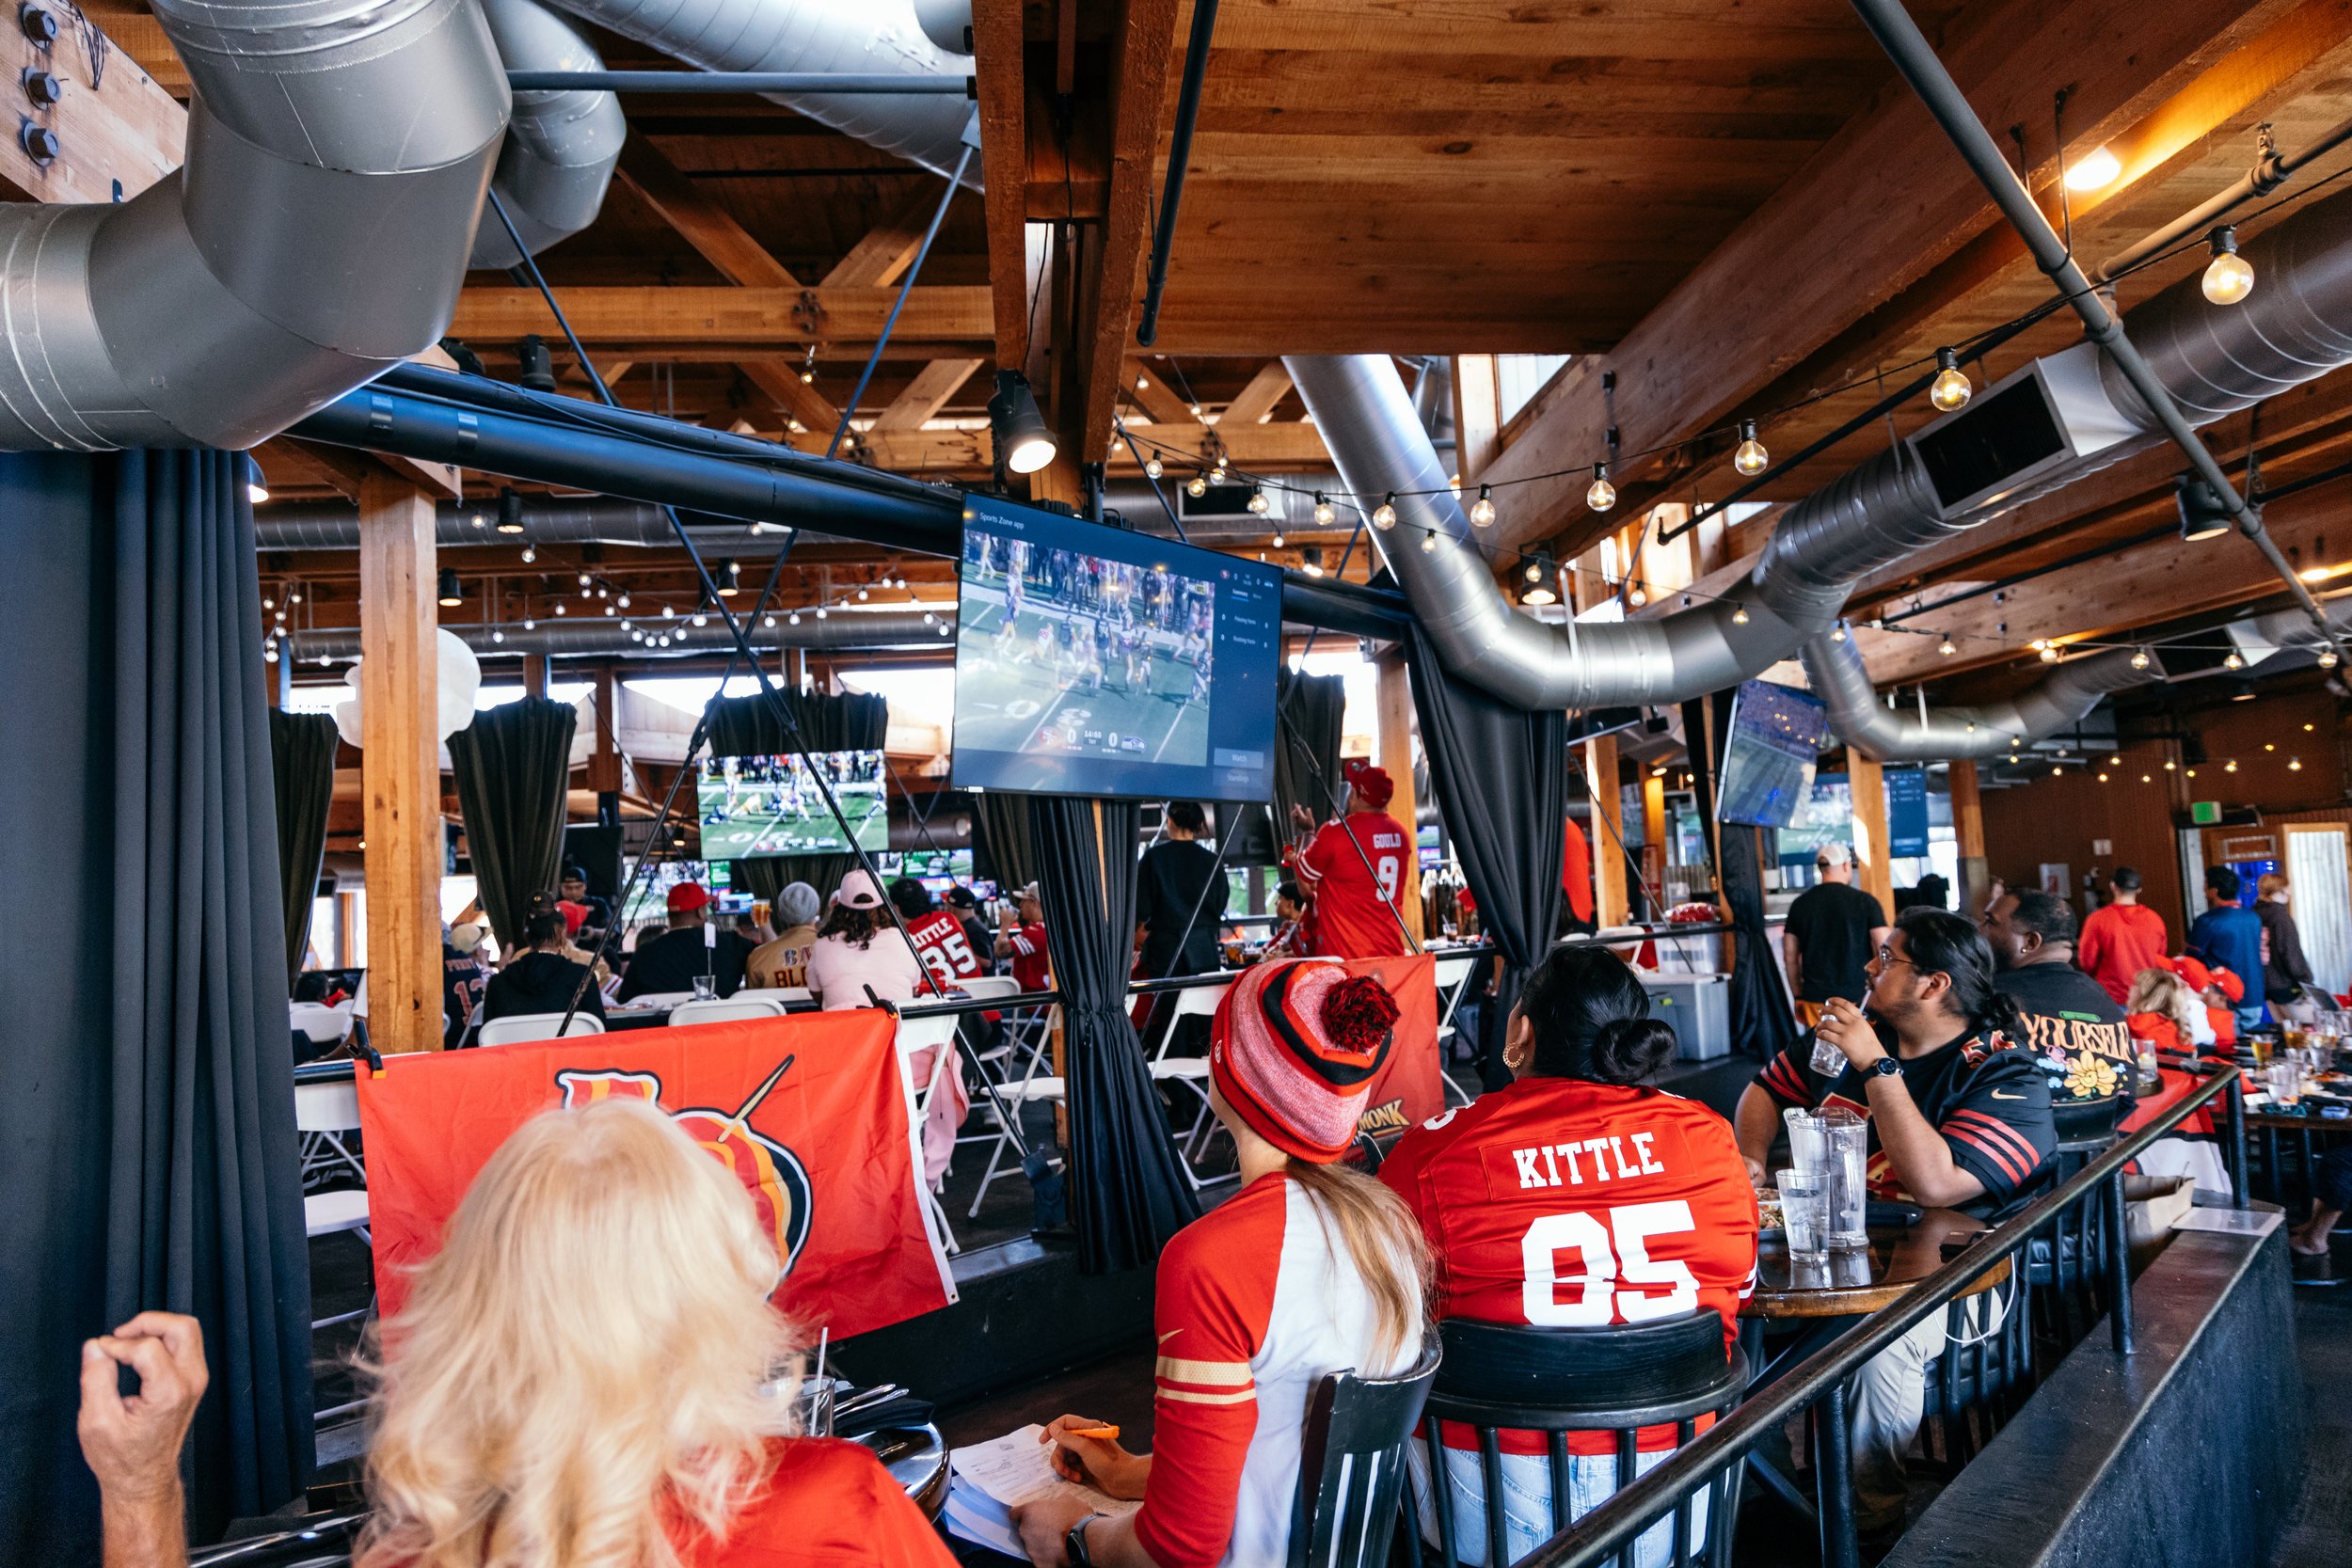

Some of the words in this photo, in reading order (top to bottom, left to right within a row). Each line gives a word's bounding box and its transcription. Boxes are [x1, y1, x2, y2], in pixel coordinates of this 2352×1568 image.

[979, 512, 998, 523] Sports
[998, 516, 1013, 527] Zone
[1013, 521, 1025, 531] app
[1067, 728, 1077, 744] 0
[1108, 732, 1118, 748] 0
[1373, 832, 1402, 849] GOULD
[1375, 855, 1399, 902] 9
[908, 916, 954, 948] KITTLE
[2019, 1011, 2136, 1065] YOURSELF
[1358, 1099, 1411, 1131] MONK
[1512, 1132, 1665, 1189] KITTLE
[1520, 1199, 1700, 1327] 85
